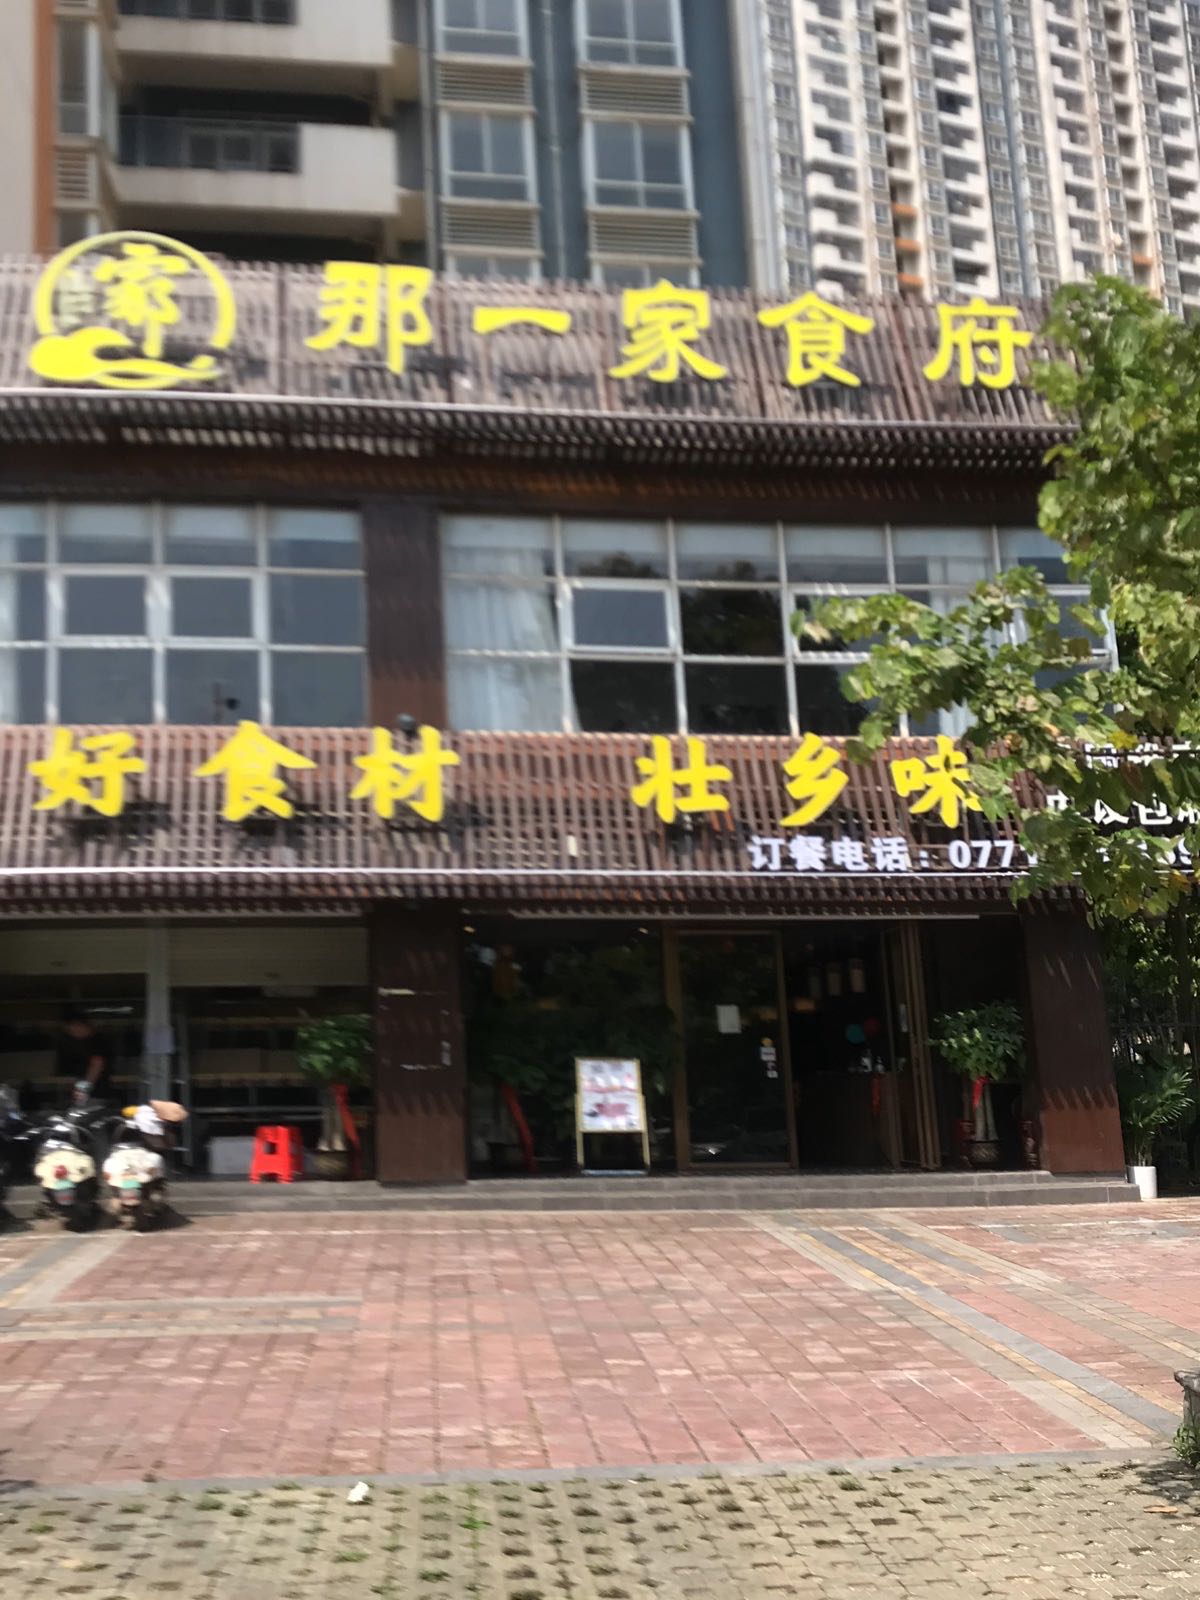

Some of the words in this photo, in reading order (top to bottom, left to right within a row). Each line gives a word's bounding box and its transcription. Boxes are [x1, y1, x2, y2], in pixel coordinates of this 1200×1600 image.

[306, 261, 1033, 390] 那一家食府
[28, 720, 460, 822] 好食材
[631, 732, 983, 829] 壮乡味
